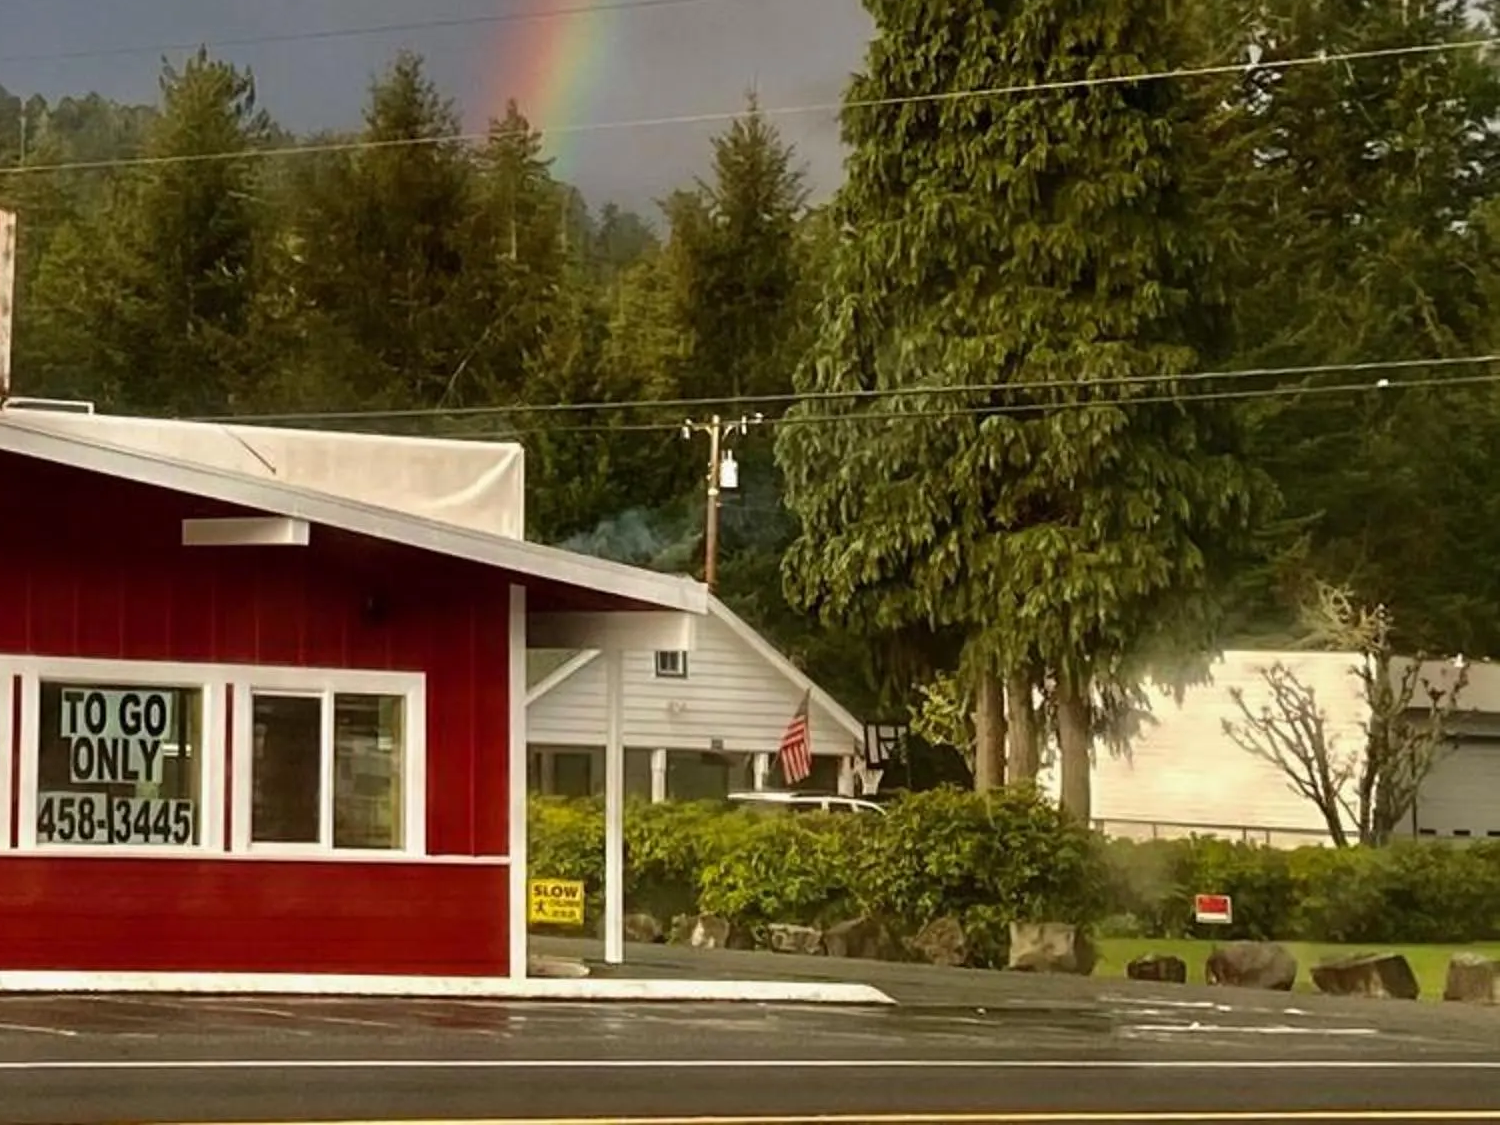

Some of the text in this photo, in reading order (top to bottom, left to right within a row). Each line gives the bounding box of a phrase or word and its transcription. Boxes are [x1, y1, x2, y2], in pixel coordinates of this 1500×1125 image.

[64, 691, 167, 737] TO GO
[73, 736, 161, 781] ONLY
[38, 796, 191, 843] 458-3445
[533, 884, 579, 898] SLOW
